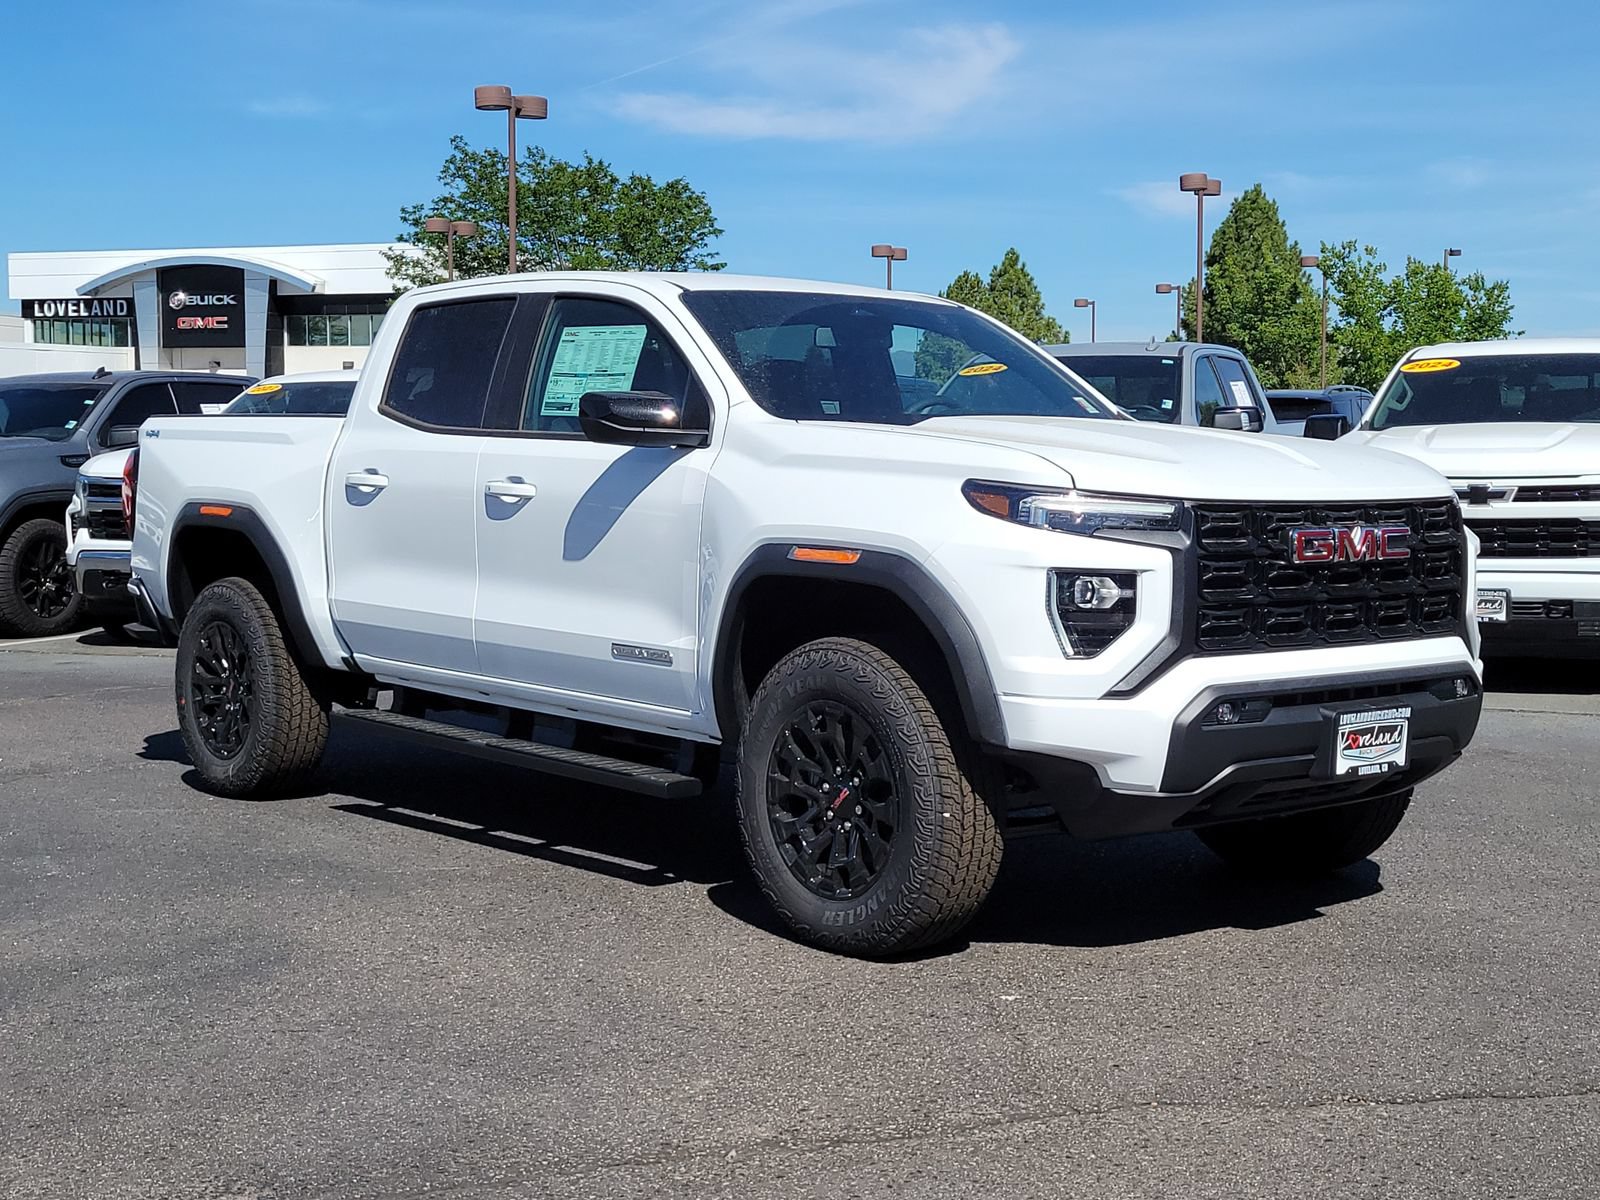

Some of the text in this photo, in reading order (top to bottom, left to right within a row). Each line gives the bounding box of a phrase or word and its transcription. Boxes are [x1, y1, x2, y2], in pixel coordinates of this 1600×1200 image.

[185, 294, 238, 306] BUICK
[33, 299, 128, 317] LOVELAND
[177, 316, 229, 329] GMC
[1289, 526, 1411, 563] GMC
